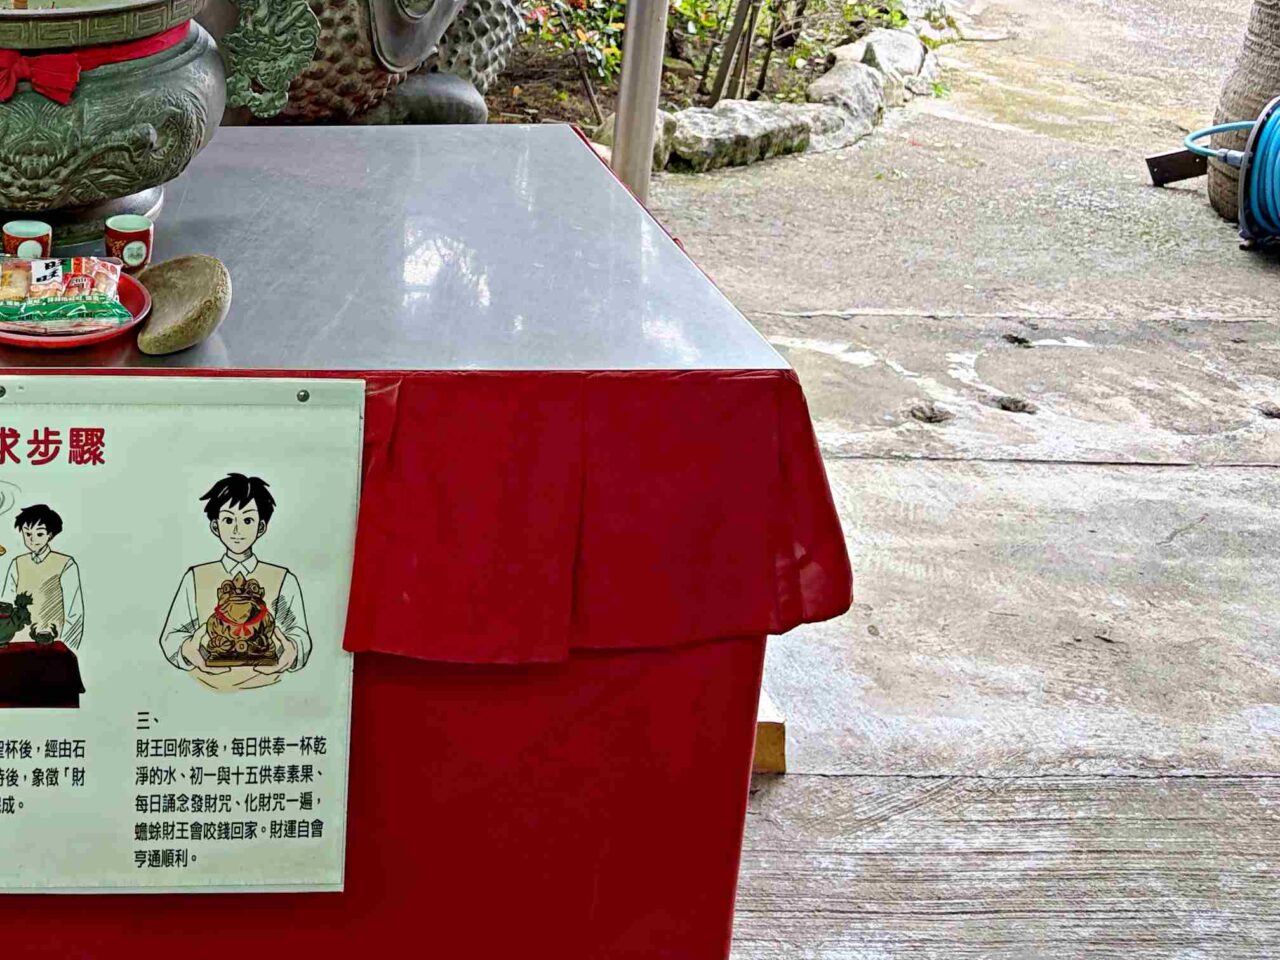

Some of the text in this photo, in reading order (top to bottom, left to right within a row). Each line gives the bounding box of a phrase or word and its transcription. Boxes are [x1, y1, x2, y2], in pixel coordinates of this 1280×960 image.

[137, 712, 158, 729] 三、
[136, 736, 326, 757] 財王回你家後，每日供奉一杯乾
[136, 765, 322, 785] 淨的水、初一與十五供奉素果、
[135, 791, 320, 813] 每日誦念發財咒、化財咒一遍，
[135, 819, 323, 841] 蟾蜍財王會咬錢回家。財運自會
[134, 848, 197, 868] 亨通順利。
